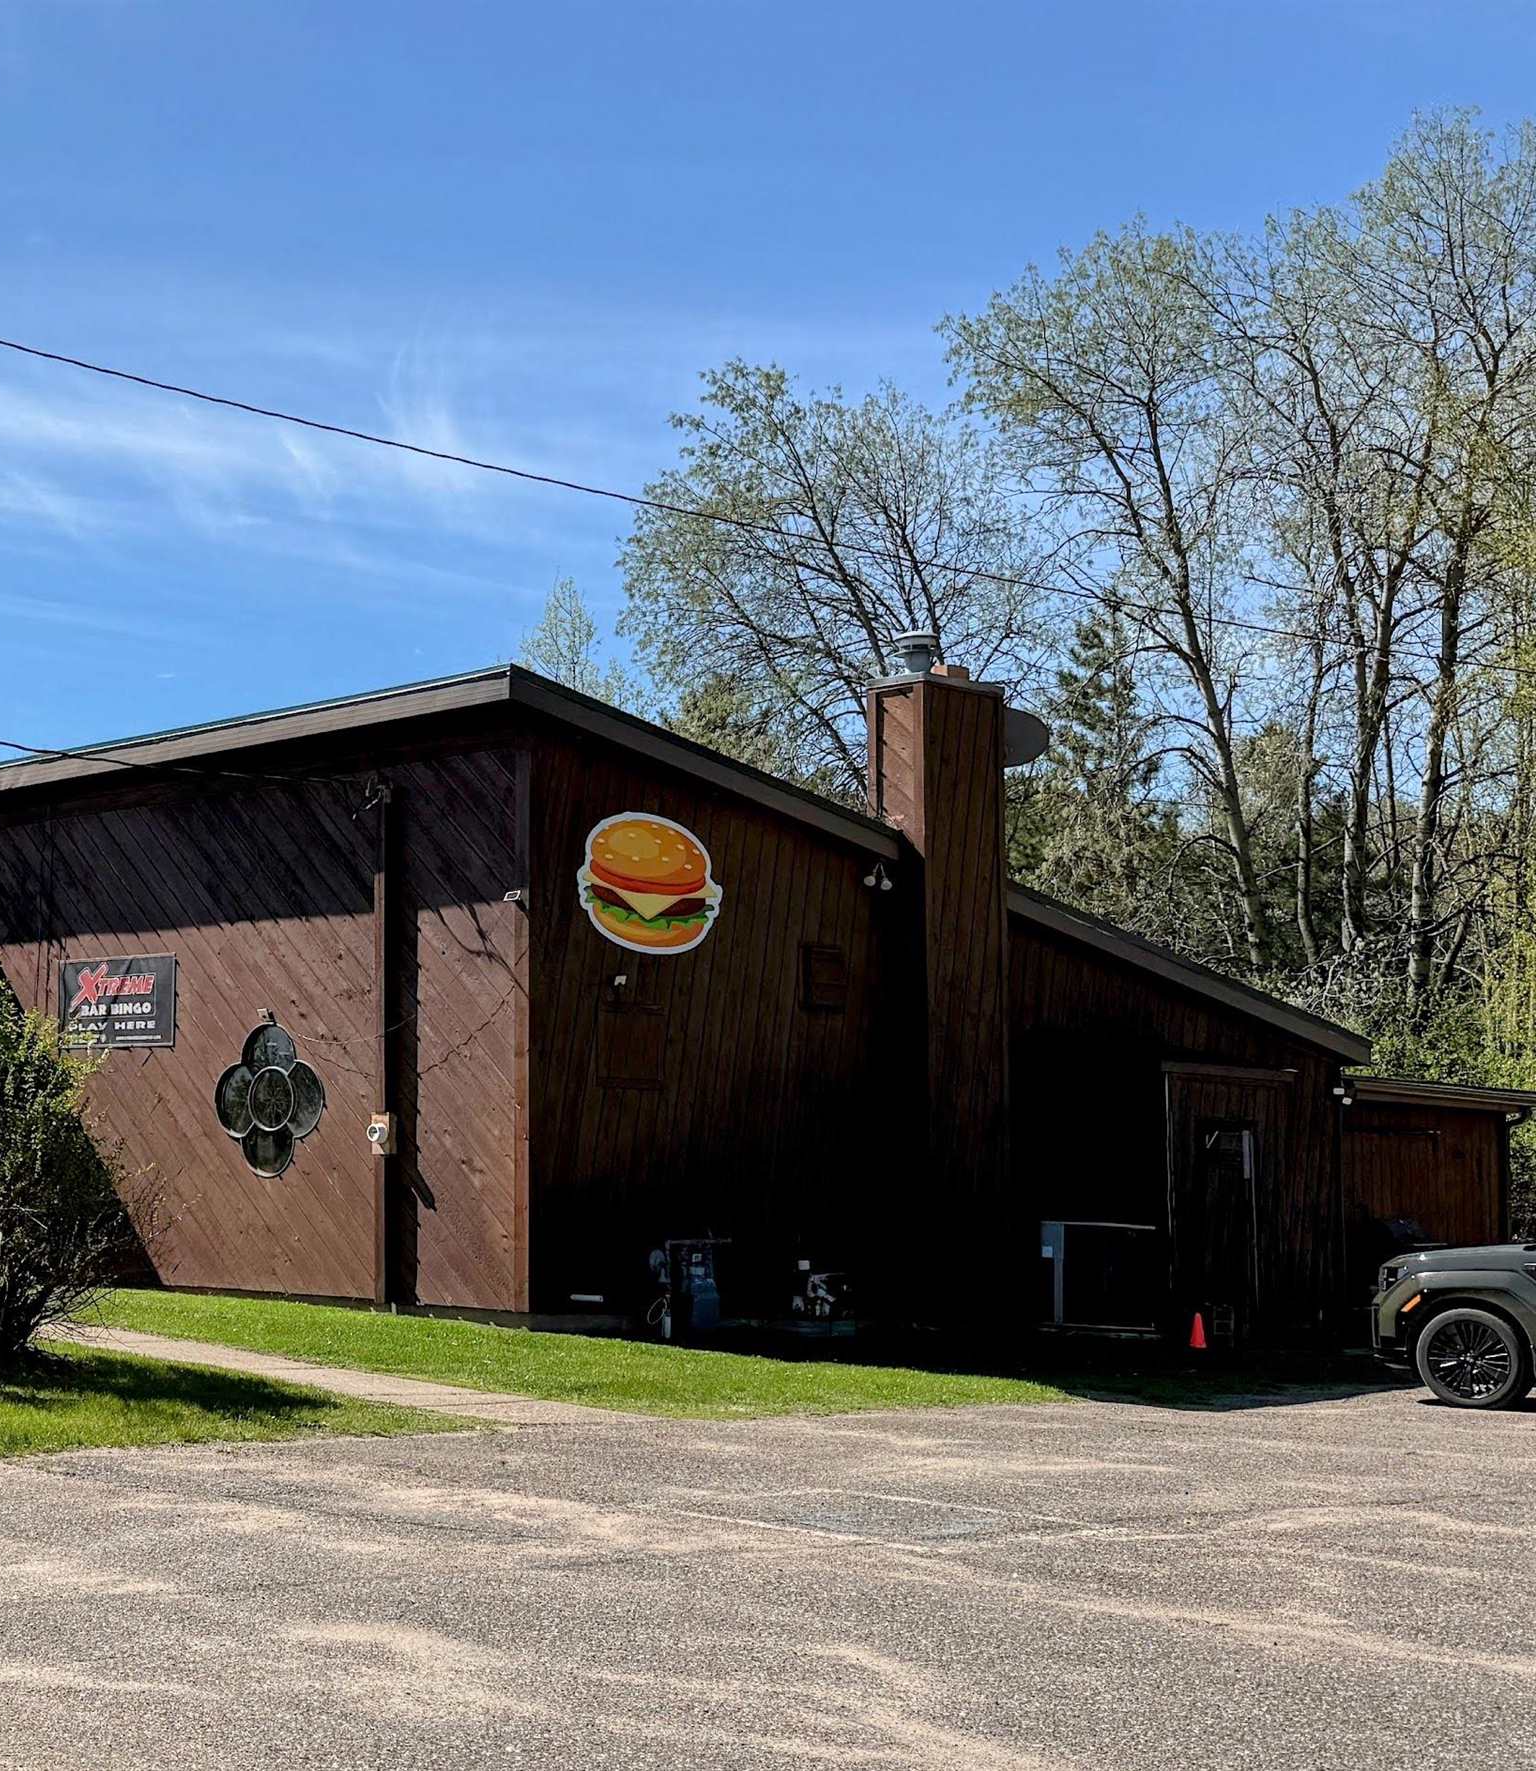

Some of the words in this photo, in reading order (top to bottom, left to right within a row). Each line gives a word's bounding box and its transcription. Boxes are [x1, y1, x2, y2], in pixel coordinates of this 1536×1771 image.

[69, 962, 155, 1012] XTREME
[81, 1003, 107, 1017] BAR
[111, 1002, 152, 1015] BINGO
[68, 1021, 107, 1032] PLAY
[114, 1020, 156, 1030] HERE
